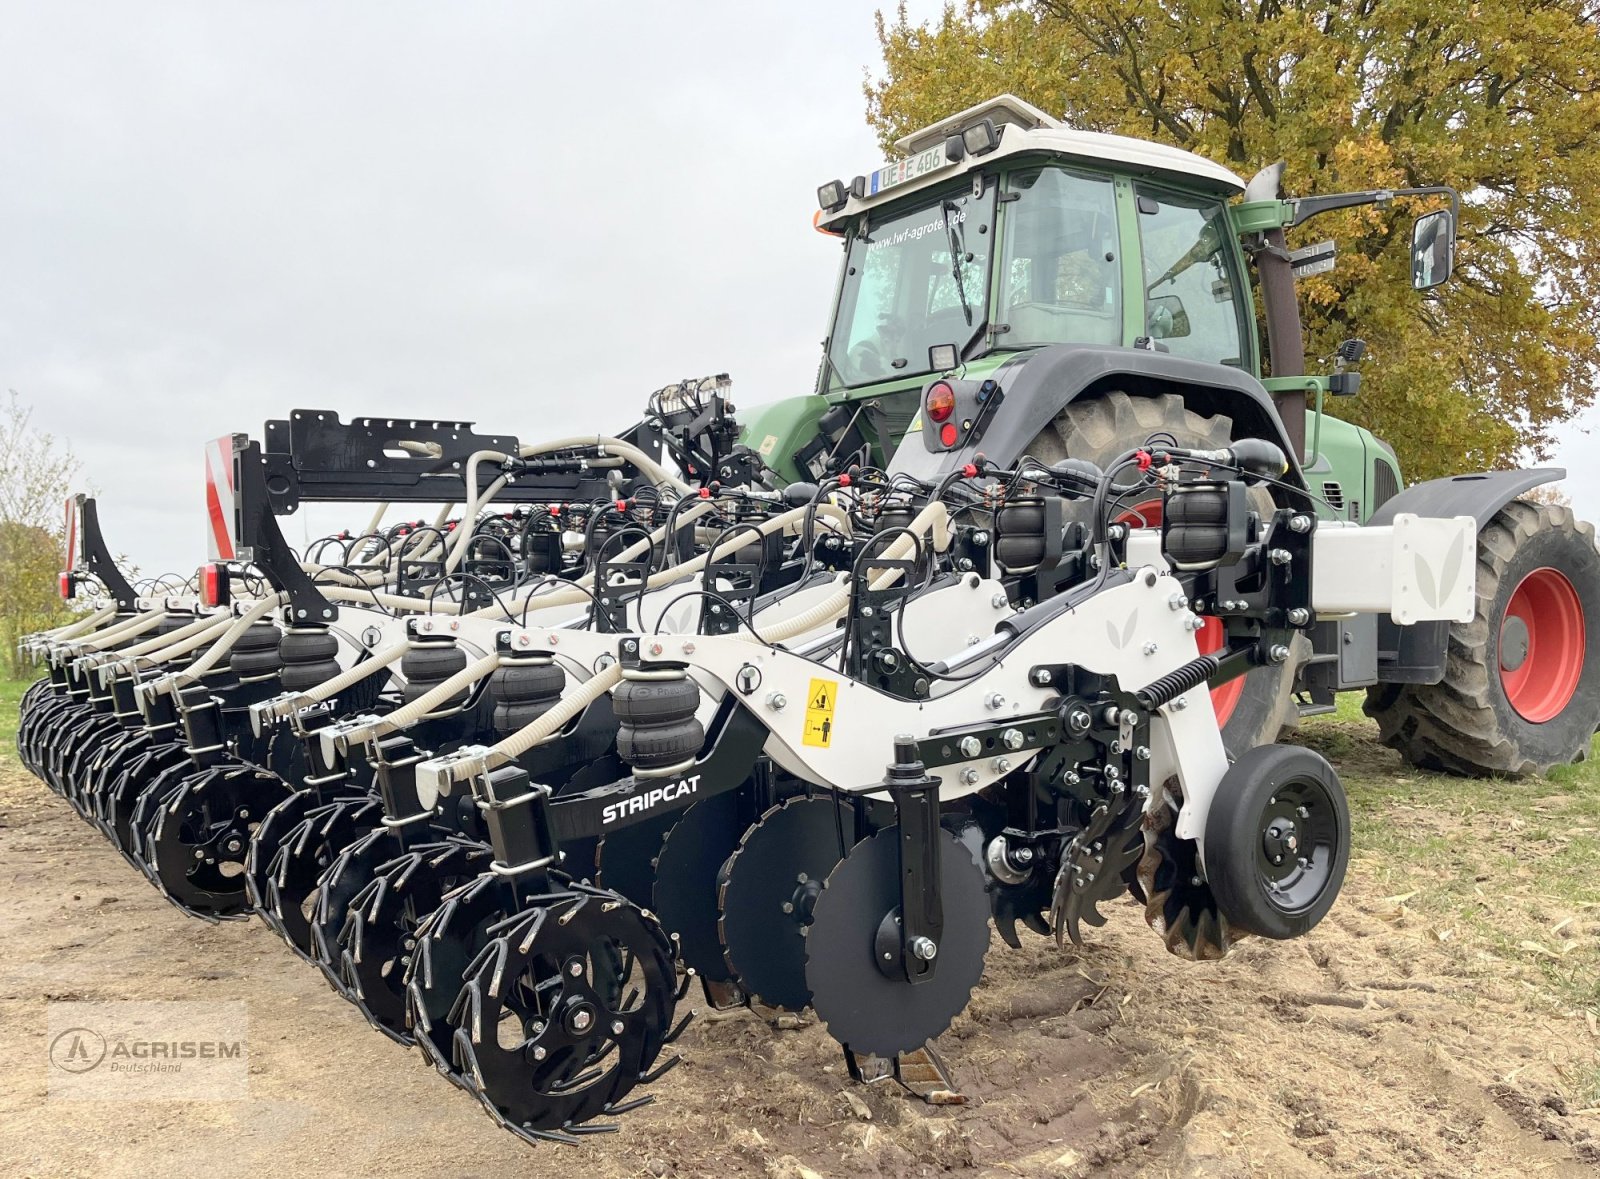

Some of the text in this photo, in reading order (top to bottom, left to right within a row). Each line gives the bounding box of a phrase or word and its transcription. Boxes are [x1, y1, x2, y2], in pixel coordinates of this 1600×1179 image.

[882, 166, 898, 188] UE
[868, 211, 967, 251] www.lwf-agrote.de
[603, 775, 700, 824] STRIPCAT
